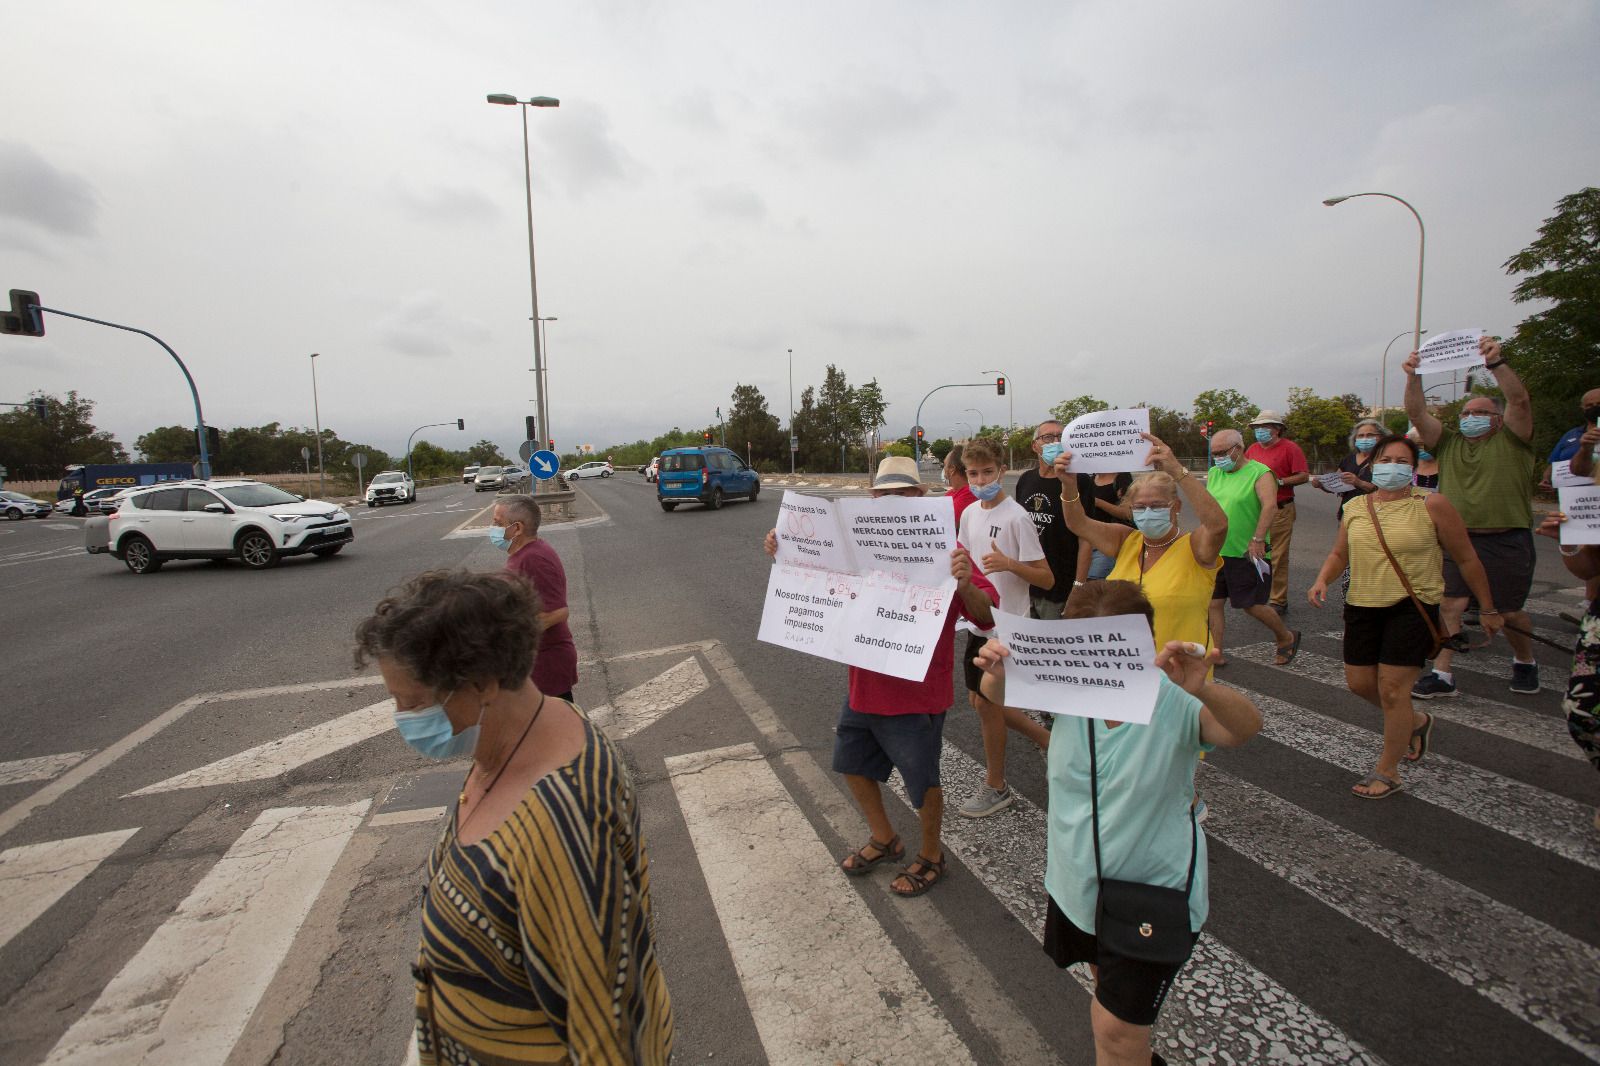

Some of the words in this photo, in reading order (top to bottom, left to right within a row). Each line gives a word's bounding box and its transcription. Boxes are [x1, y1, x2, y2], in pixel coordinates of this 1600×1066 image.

[1073, 420, 1117, 432] ¡QUEREMOS
[1069, 430, 1105, 439] MERCADO
[854, 515, 907, 525] ¡QUEREMOS
[924, 514, 937, 522] AL
[852, 527, 894, 536] MERCADO
[896, 526, 945, 536] CENTRAL!
[856, 540, 890, 549] VUELTA
[891, 542, 910, 550] DEL
[873, 552, 902, 562] VECINOS
[775, 588, 810, 604] Nosotros
[812, 593, 844, 609] también
[924, 598, 942, 611] 05
[788, 604, 824, 620] pagamos
[784, 617, 824, 633] impuestos
[854, 634, 902, 652] abandono
[904, 642, 925, 656] total
[1011, 632, 1085, 645] ¡QUEREMOS
[1088, 634, 1104, 644] IR
[1108, 632, 1126, 642] AL
[1008, 642, 1067, 656] MERCADO
[1070, 648, 1140, 657] CENTRAL!
[1012, 657, 1061, 668] VUELTA
[1064, 660, 1090, 668] DEL
[1092, 661, 1110, 670] 04
[1112, 662, 1123, 670] Y
[1126, 662, 1144, 672] 05
[1034, 674, 1080, 684] VECINOS
[1082, 677, 1126, 689] RABASA
